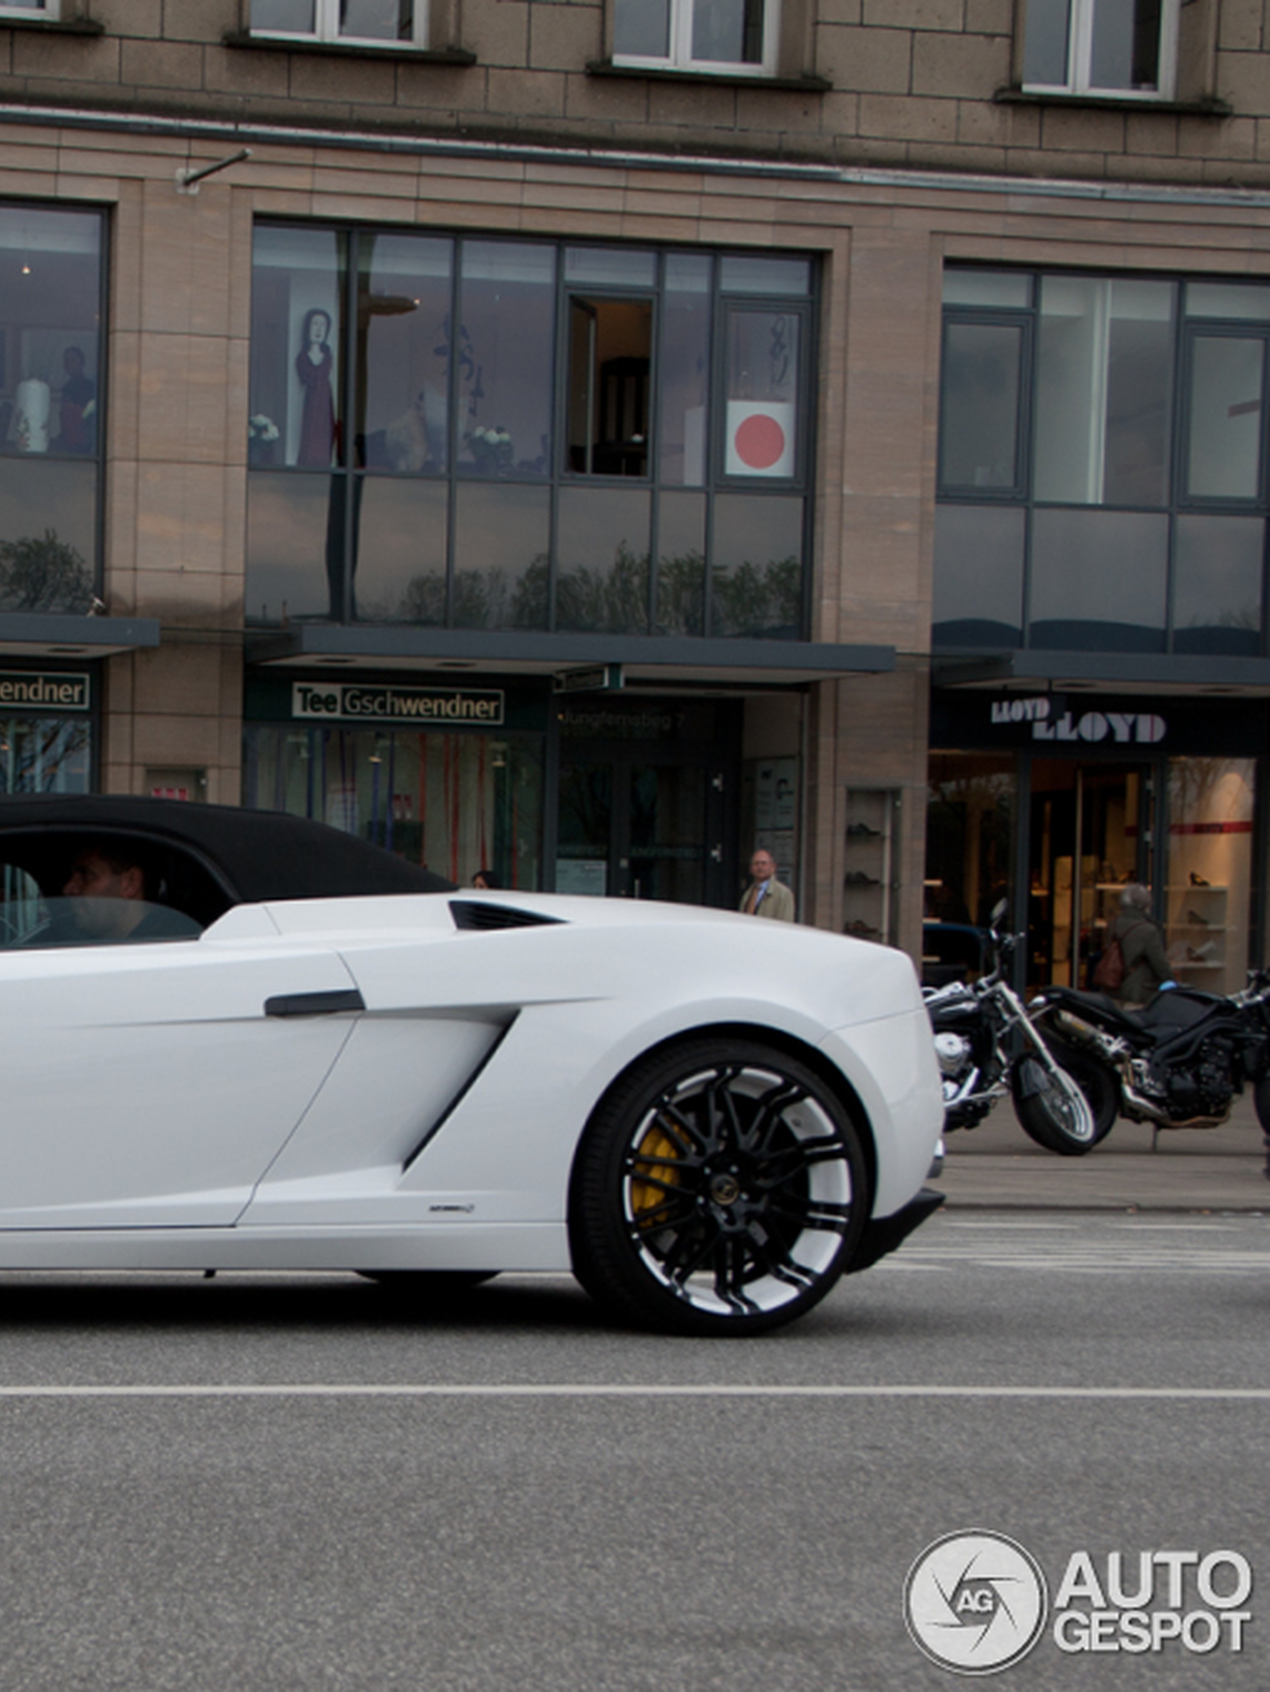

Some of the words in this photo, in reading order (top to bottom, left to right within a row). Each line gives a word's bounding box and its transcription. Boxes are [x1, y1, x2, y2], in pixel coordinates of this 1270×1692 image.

[297, 687, 337, 713] Tee
[344, 689, 500, 718] Gschwendner
[991, 697, 1050, 724] LLOYD
[1032, 711, 1167, 743] LLOYD
